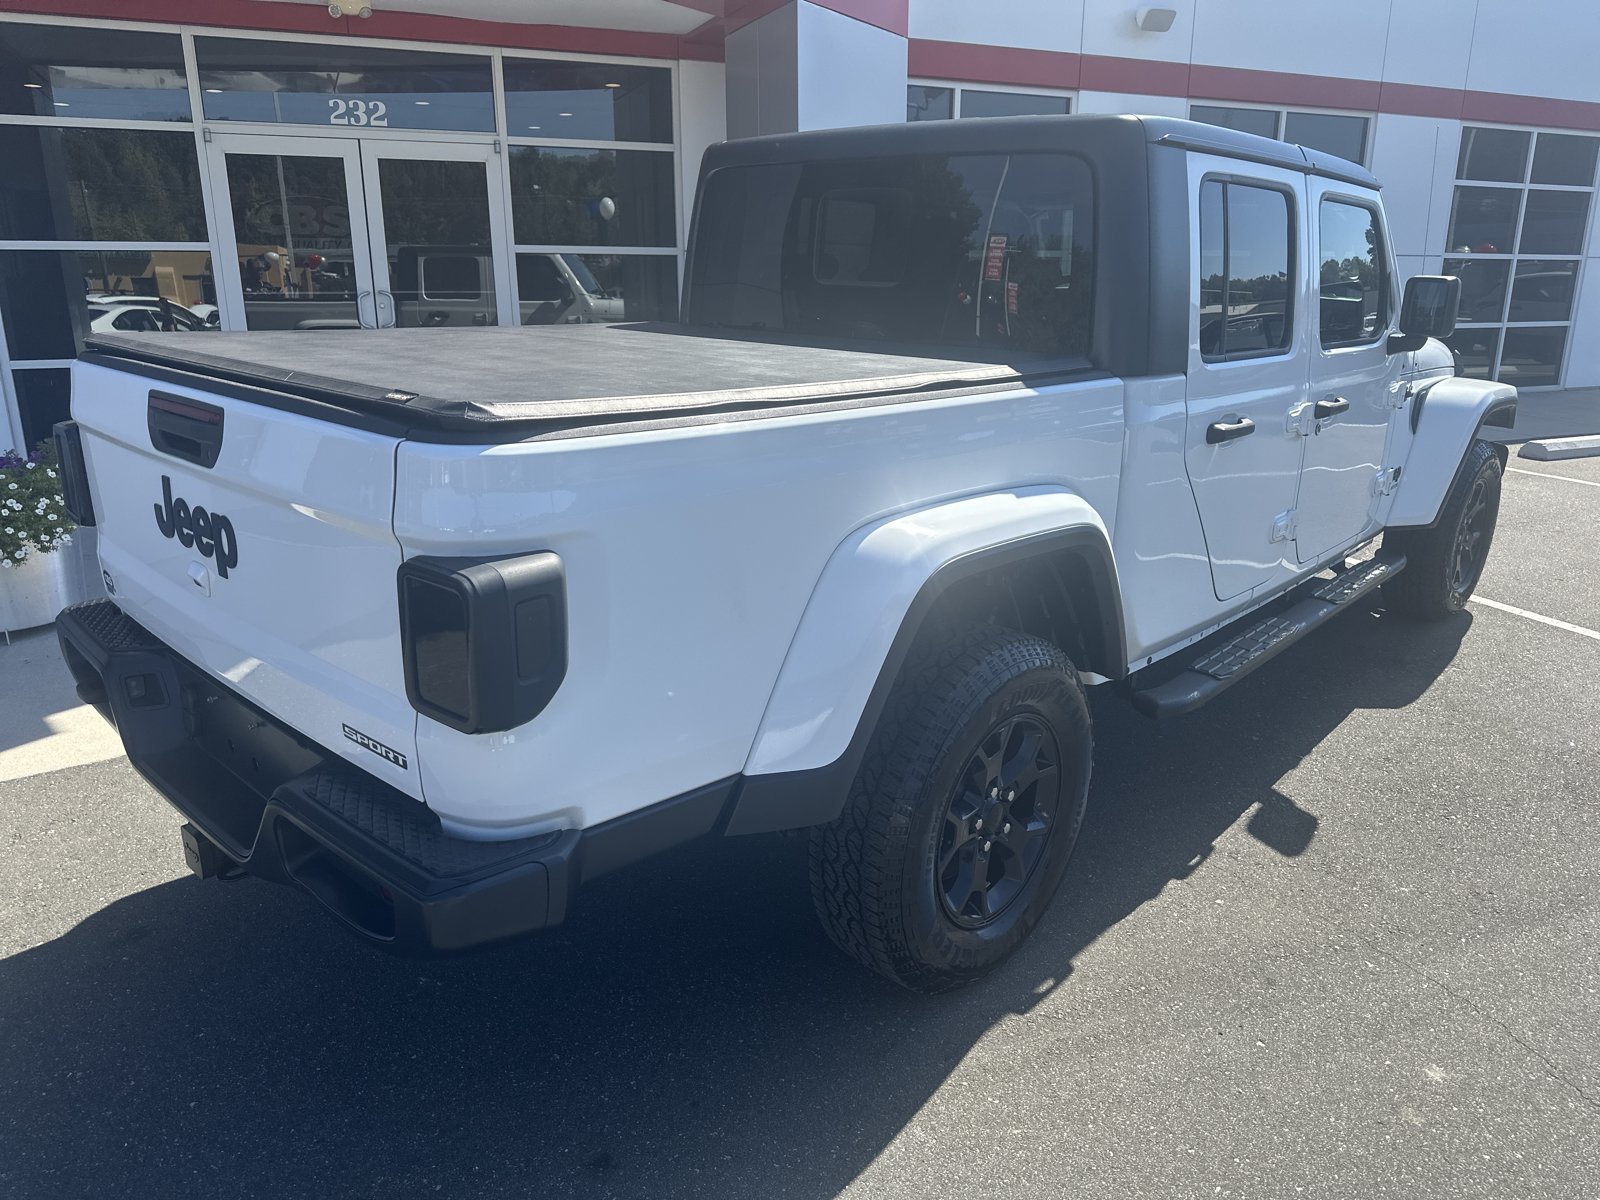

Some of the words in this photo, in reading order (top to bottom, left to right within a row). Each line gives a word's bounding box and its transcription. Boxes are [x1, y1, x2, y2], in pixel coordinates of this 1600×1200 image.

[328, 98, 388, 127] 232
[154, 475, 238, 579] Jeep
[342, 723, 408, 769] SPORT
